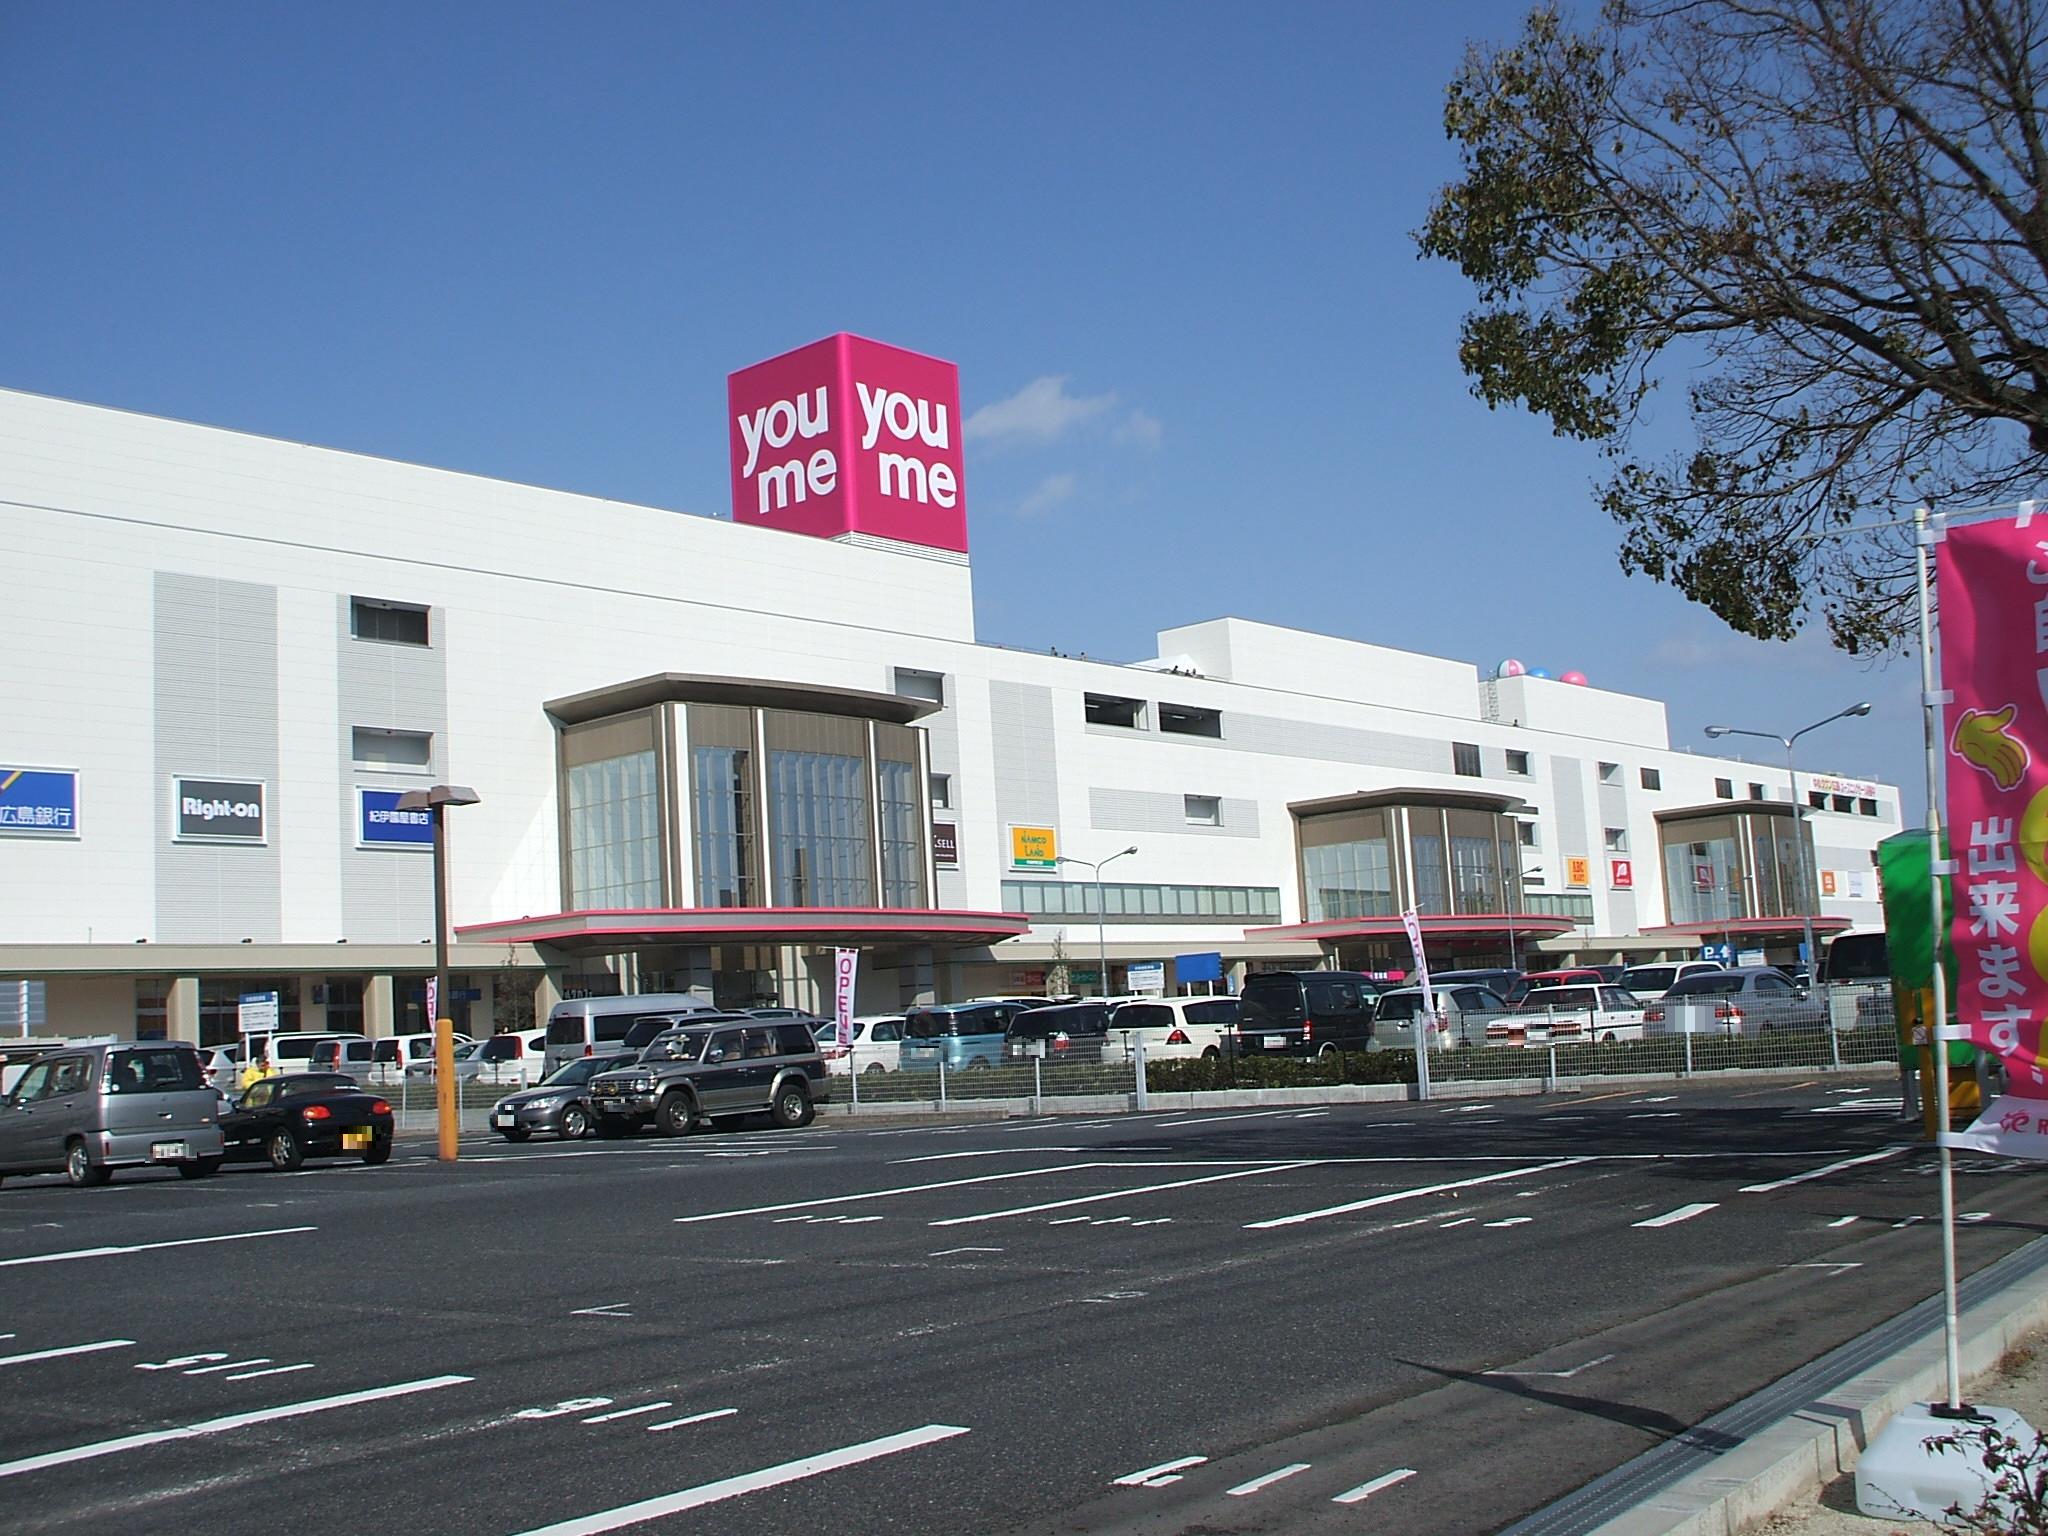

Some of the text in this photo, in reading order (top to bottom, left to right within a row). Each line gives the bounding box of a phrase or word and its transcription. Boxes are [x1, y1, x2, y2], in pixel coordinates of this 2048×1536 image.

[737, 385, 830, 479] you
[855, 381, 949, 450] you
[757, 447, 837, 515] me
[878, 451, 958, 509] me
[0, 806, 72, 826] 広島銀行
[1704, 946, 1714, 959] P
[1967, 815, 2033, 1058] 出来ます
